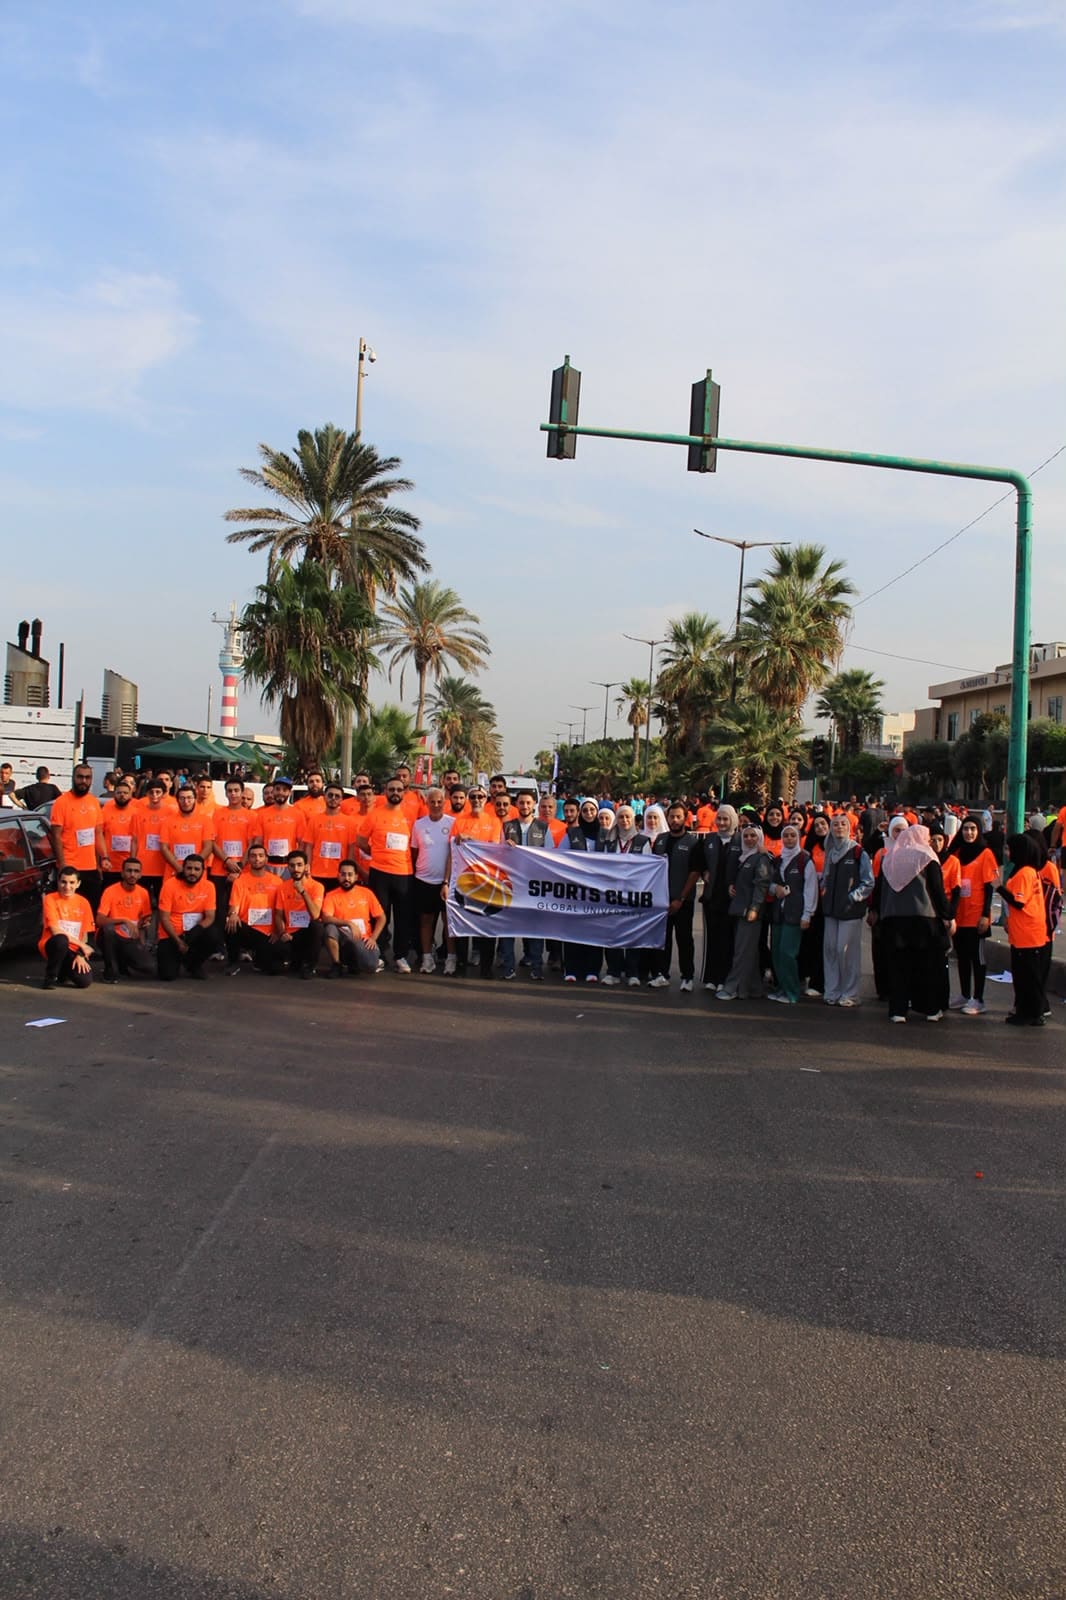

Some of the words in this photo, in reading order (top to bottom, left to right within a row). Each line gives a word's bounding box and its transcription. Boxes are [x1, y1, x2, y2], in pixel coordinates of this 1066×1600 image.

[528, 880, 601, 903] SPORTS
[605, 889, 653, 908] CLUB
[537, 902, 577, 912] GLOBAL
